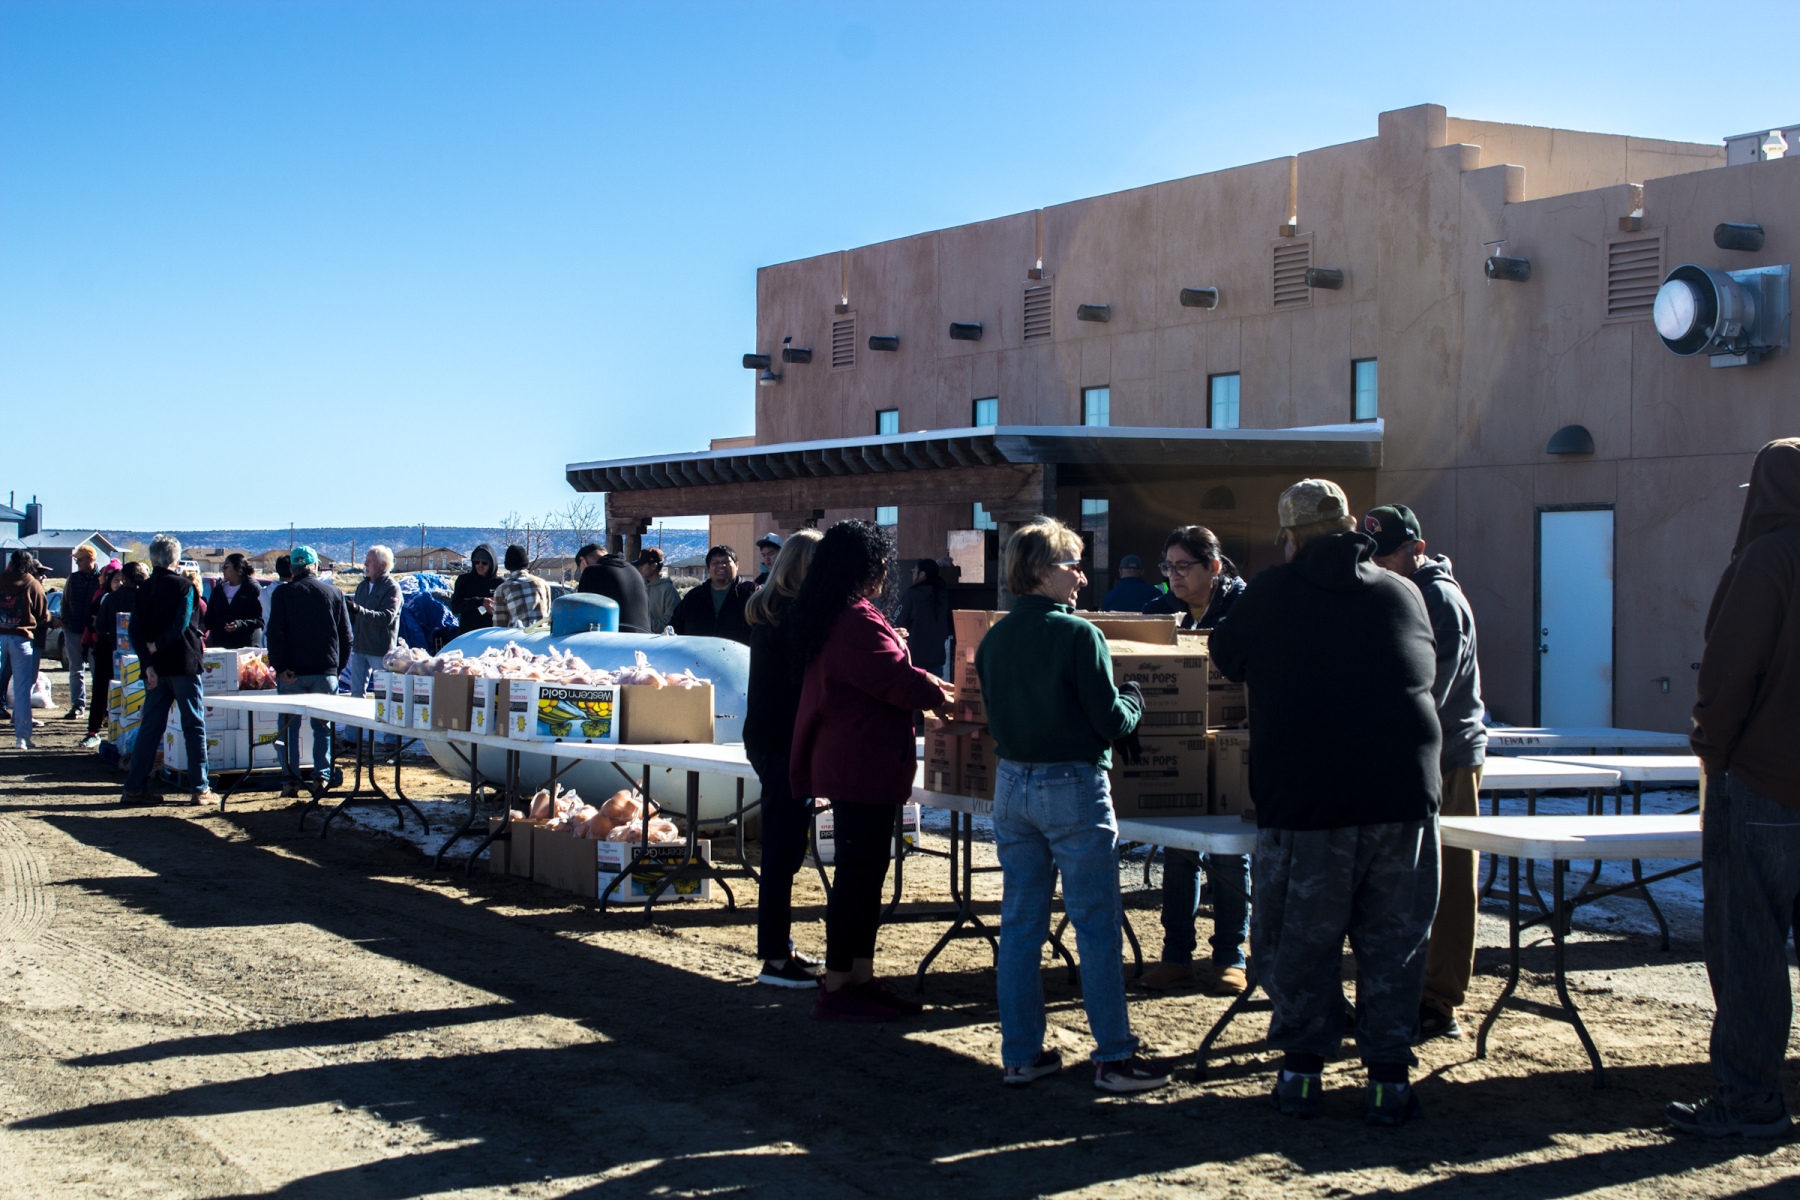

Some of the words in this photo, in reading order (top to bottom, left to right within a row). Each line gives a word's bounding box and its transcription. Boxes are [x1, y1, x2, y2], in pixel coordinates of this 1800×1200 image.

[1123, 673, 1149, 683] CORN
[1152, 673, 1177, 683] POPS
[541, 688, 567, 699] Gold
[568, 690, 612, 701] Western
[1498, 737, 1524, 746] TEWA
[1129, 756, 1149, 766] ORN
[1153, 756, 1177, 766] POPS
[1220, 794, 1228, 811] 4
[634, 848, 658, 859] God
